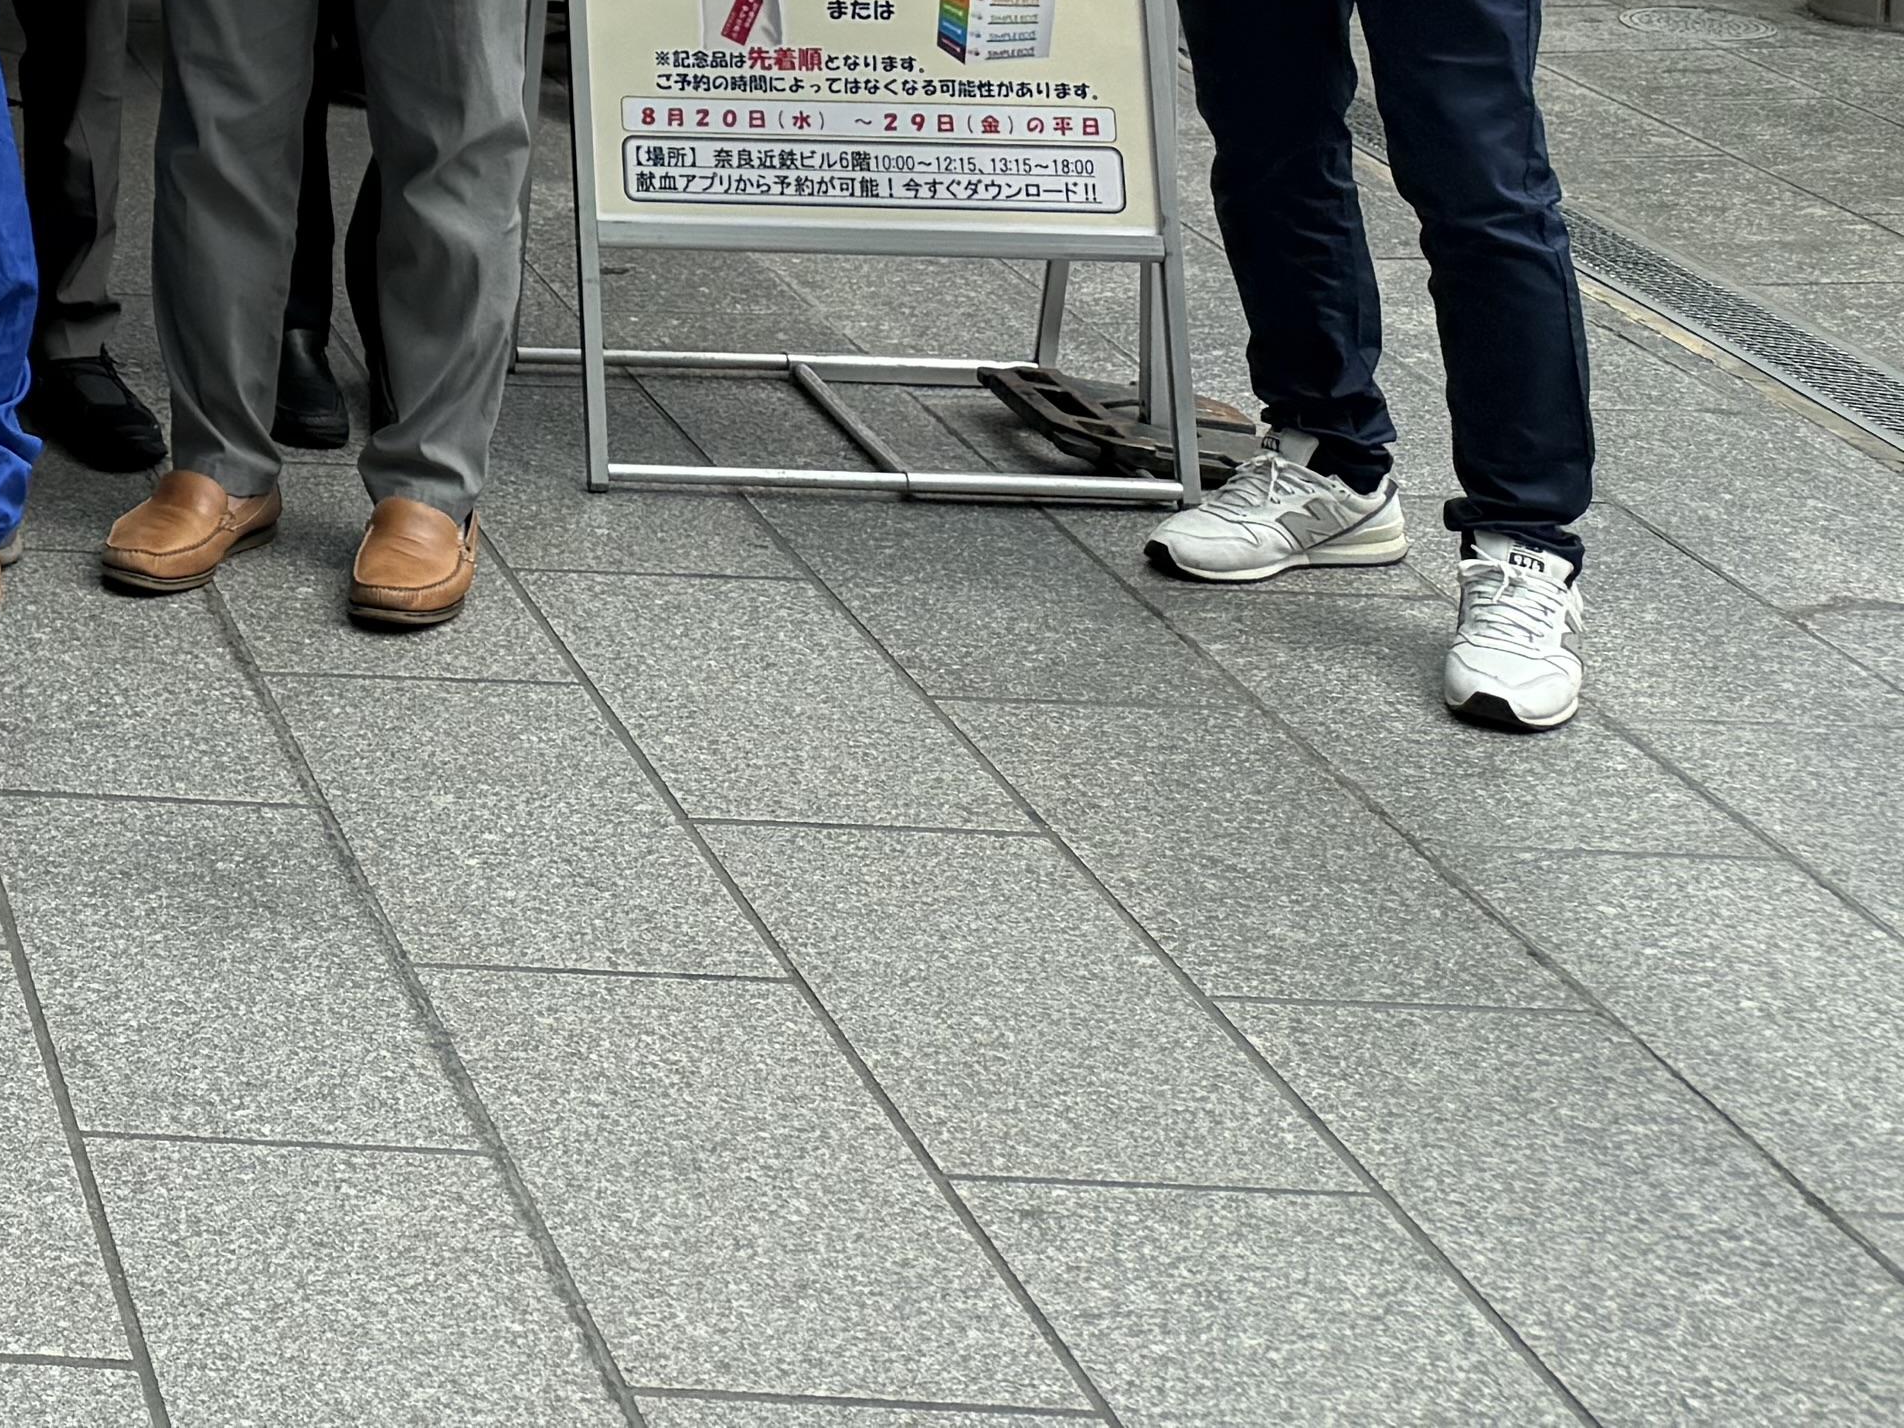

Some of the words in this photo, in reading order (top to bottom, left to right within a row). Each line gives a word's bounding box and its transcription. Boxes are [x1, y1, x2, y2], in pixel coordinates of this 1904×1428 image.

[827, 0, 895, 20] または
[655, 46, 925, 74] ※記念品は先着順となります。
[656, 74, 1098, 101] ご予約の時間によってはなくなる可能性があります。
[634, 145, 699, 168] 【場所】
